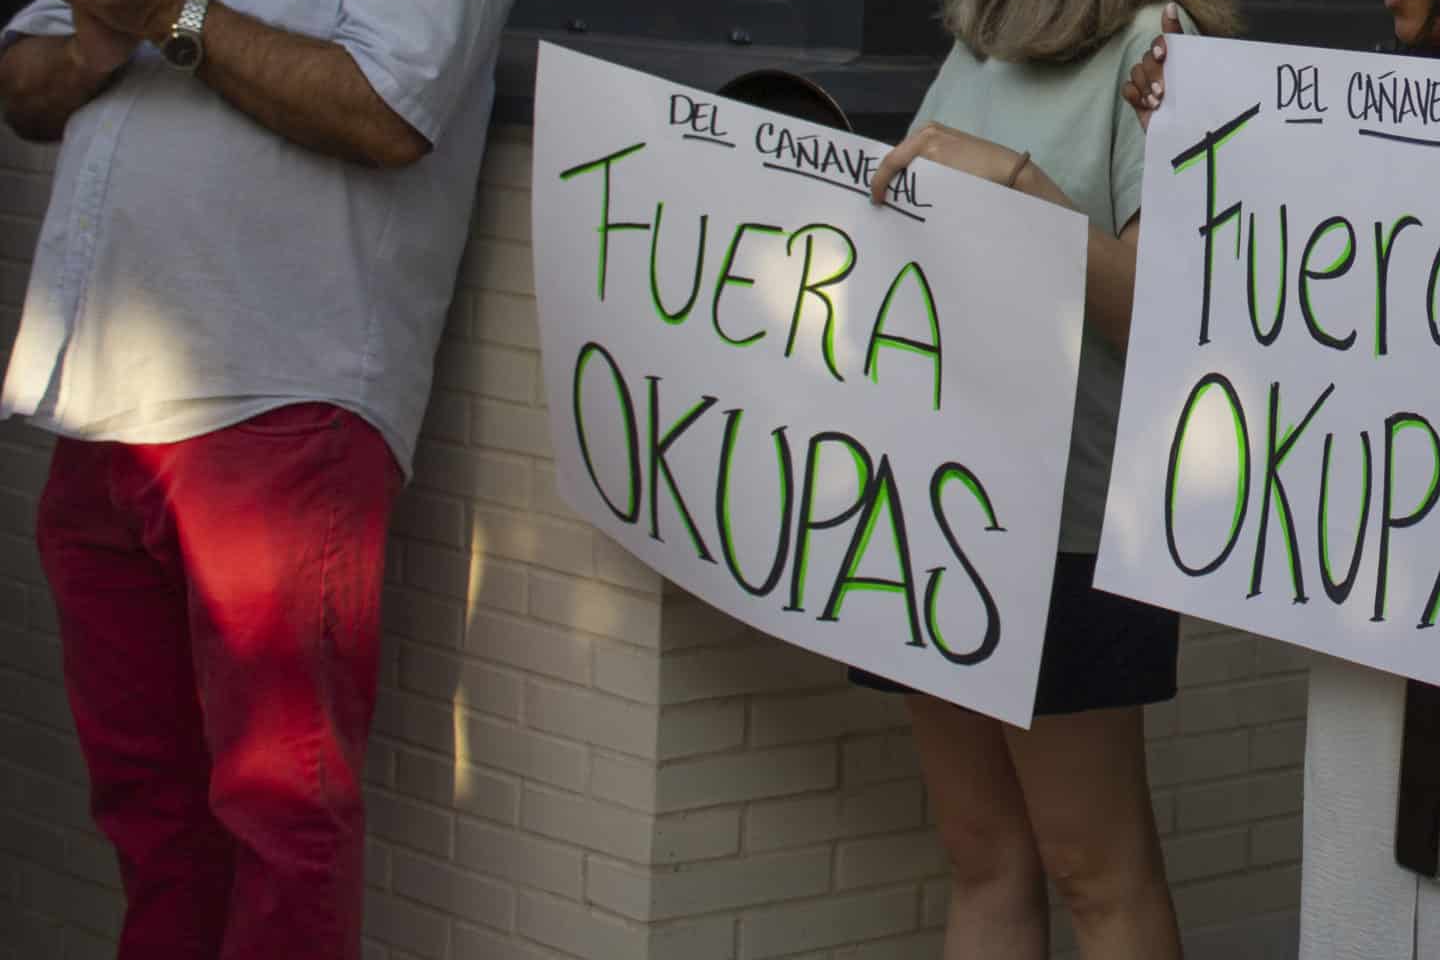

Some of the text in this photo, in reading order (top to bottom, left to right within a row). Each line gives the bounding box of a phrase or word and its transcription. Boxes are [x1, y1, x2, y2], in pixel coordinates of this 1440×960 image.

[670, 94, 932, 207] DEL CAÑAVEAL
[1276, 64, 1328, 112] DEL
[560, 142, 942, 411] FUERA
[573, 342, 1007, 665] OKUPAS
